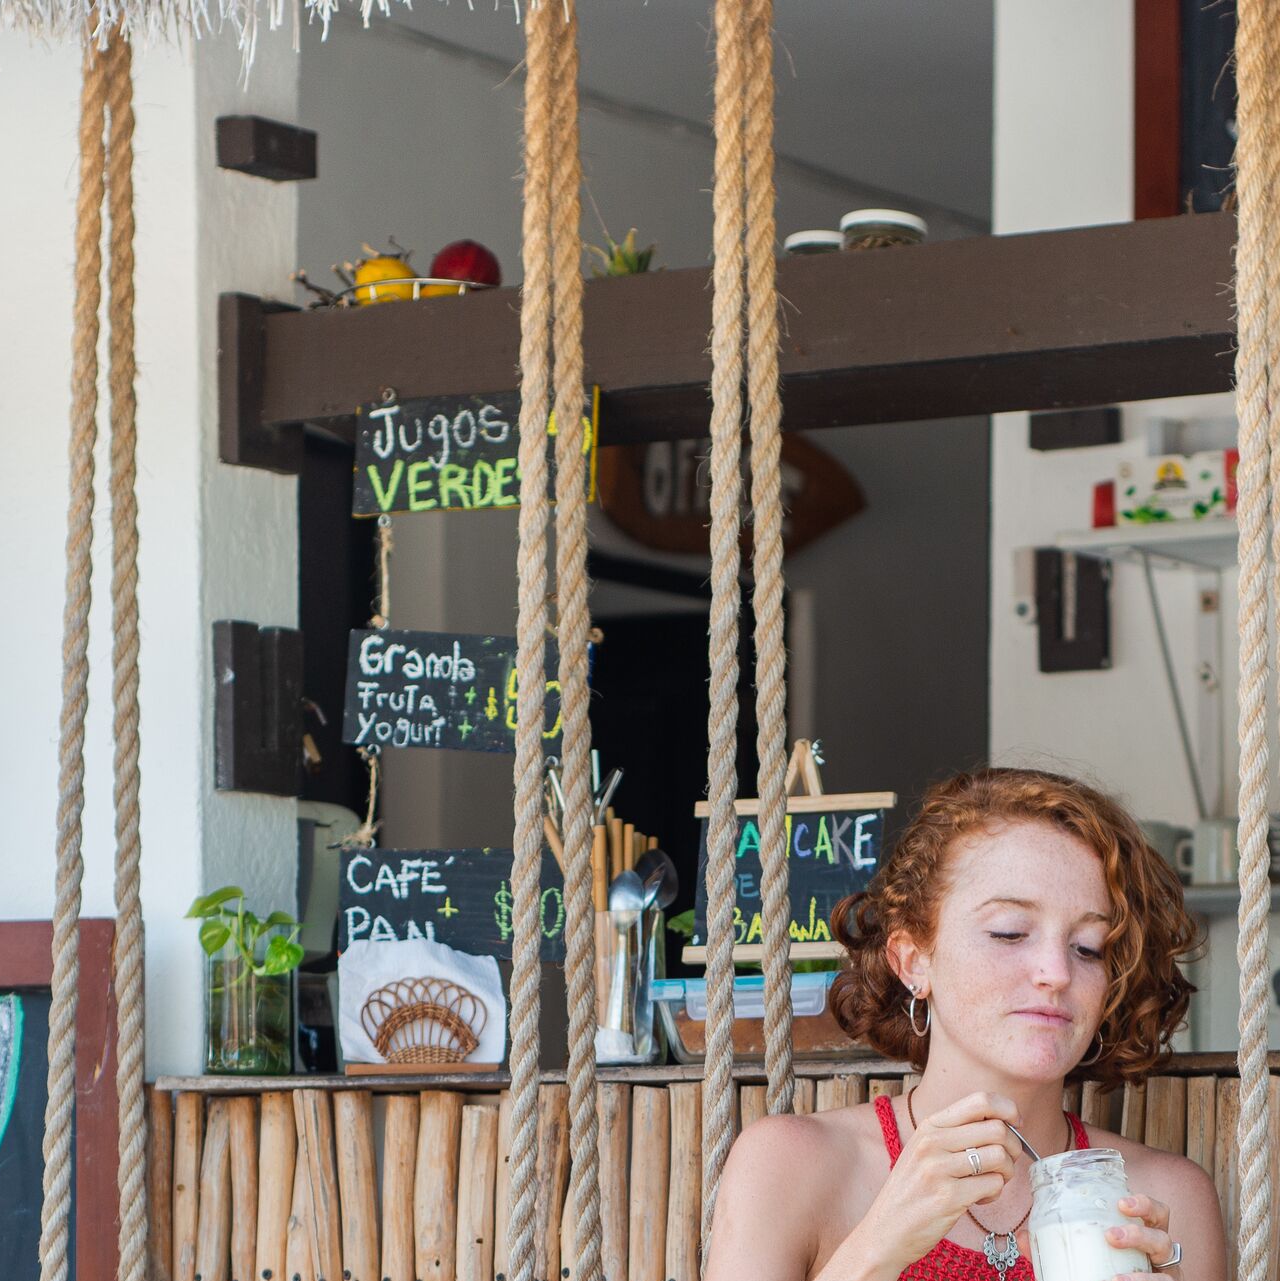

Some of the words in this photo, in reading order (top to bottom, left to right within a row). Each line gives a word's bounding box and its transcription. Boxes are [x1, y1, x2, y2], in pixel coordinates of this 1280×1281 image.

[369, 405, 509, 470] Jugos
[367, 457, 522, 512] VERDE
[359, 634, 476, 682] Granola
[735, 813, 878, 871] ACAKE
[344, 905, 436, 943] PAN
[494, 880, 566, 940] $0
